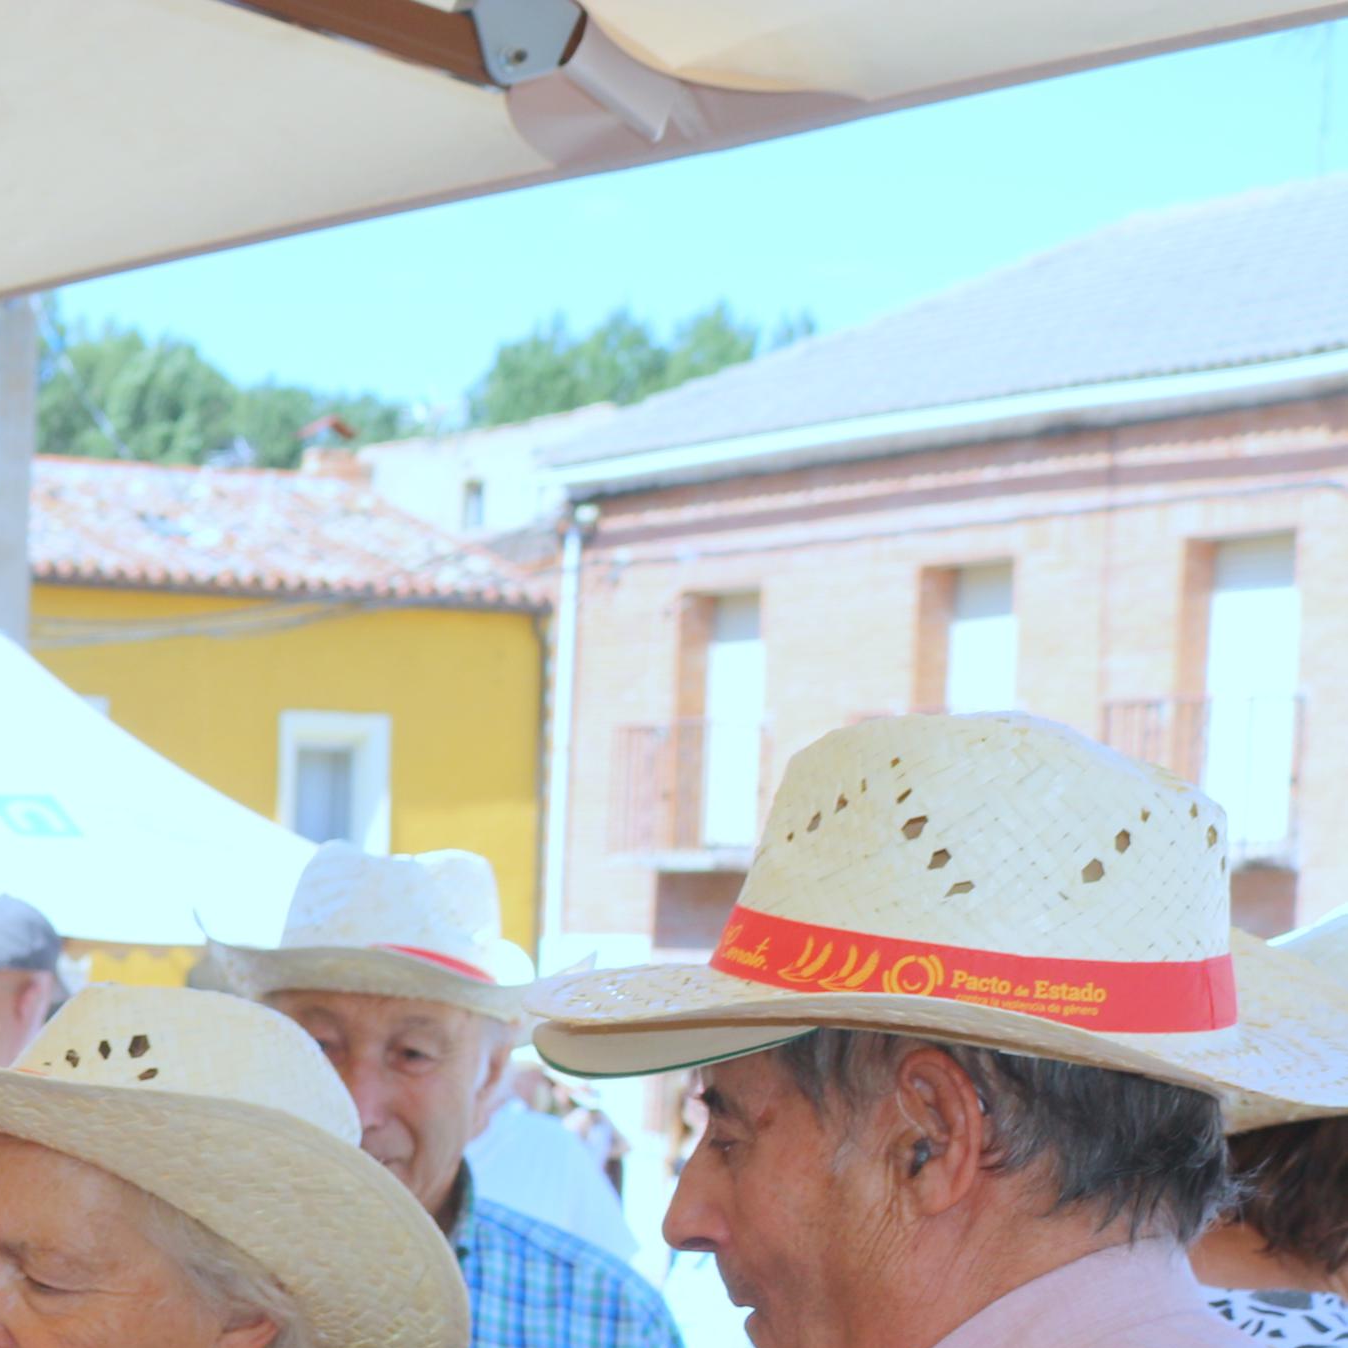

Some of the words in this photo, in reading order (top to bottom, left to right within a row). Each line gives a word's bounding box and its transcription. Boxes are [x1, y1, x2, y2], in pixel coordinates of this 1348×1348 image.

[951, 970, 1012, 995] Pacto
[1013, 985, 1030, 998] de
[1033, 980, 1107, 1003] Estado
